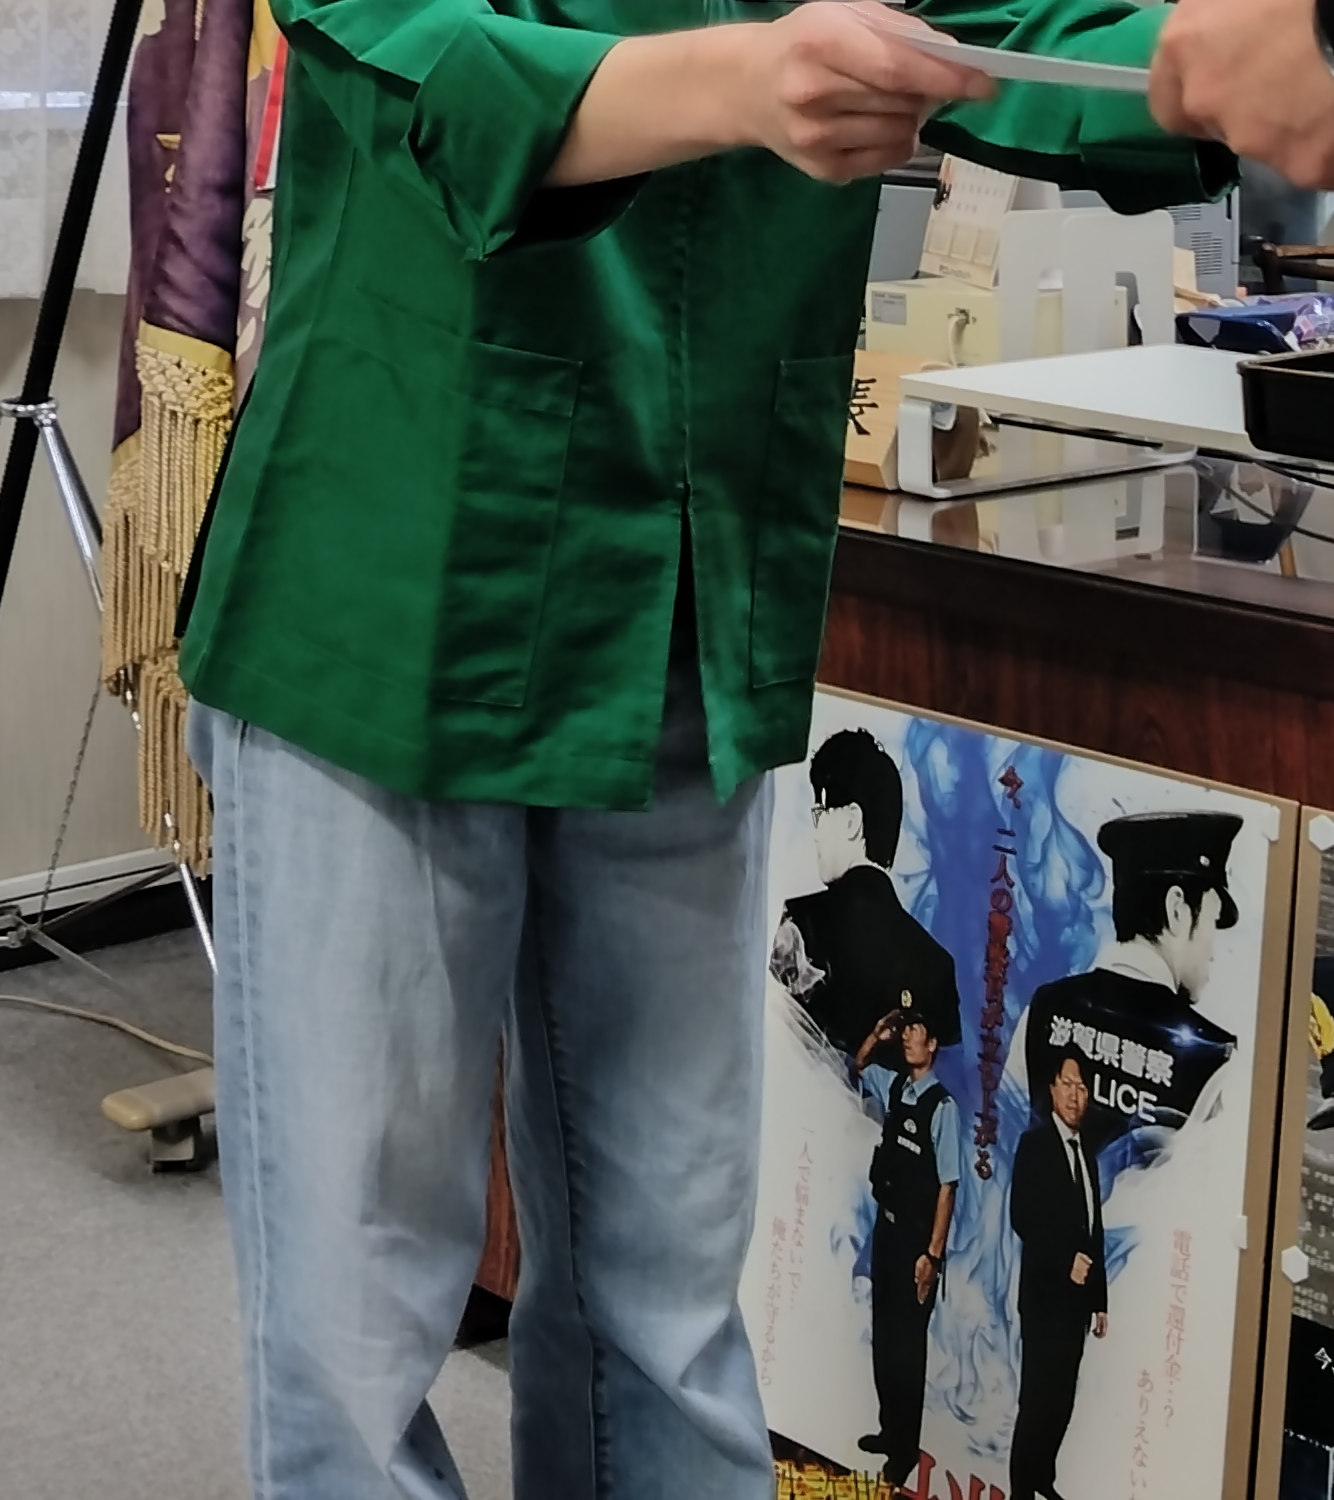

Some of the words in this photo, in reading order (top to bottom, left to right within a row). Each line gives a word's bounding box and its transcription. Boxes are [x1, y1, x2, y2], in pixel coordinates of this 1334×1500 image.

[1048, 1014, 1175, 1088] 滋賀県警察
[1093, 1072, 1159, 1124] LICE
[1129, 1368, 1155, 1500] ありえない
